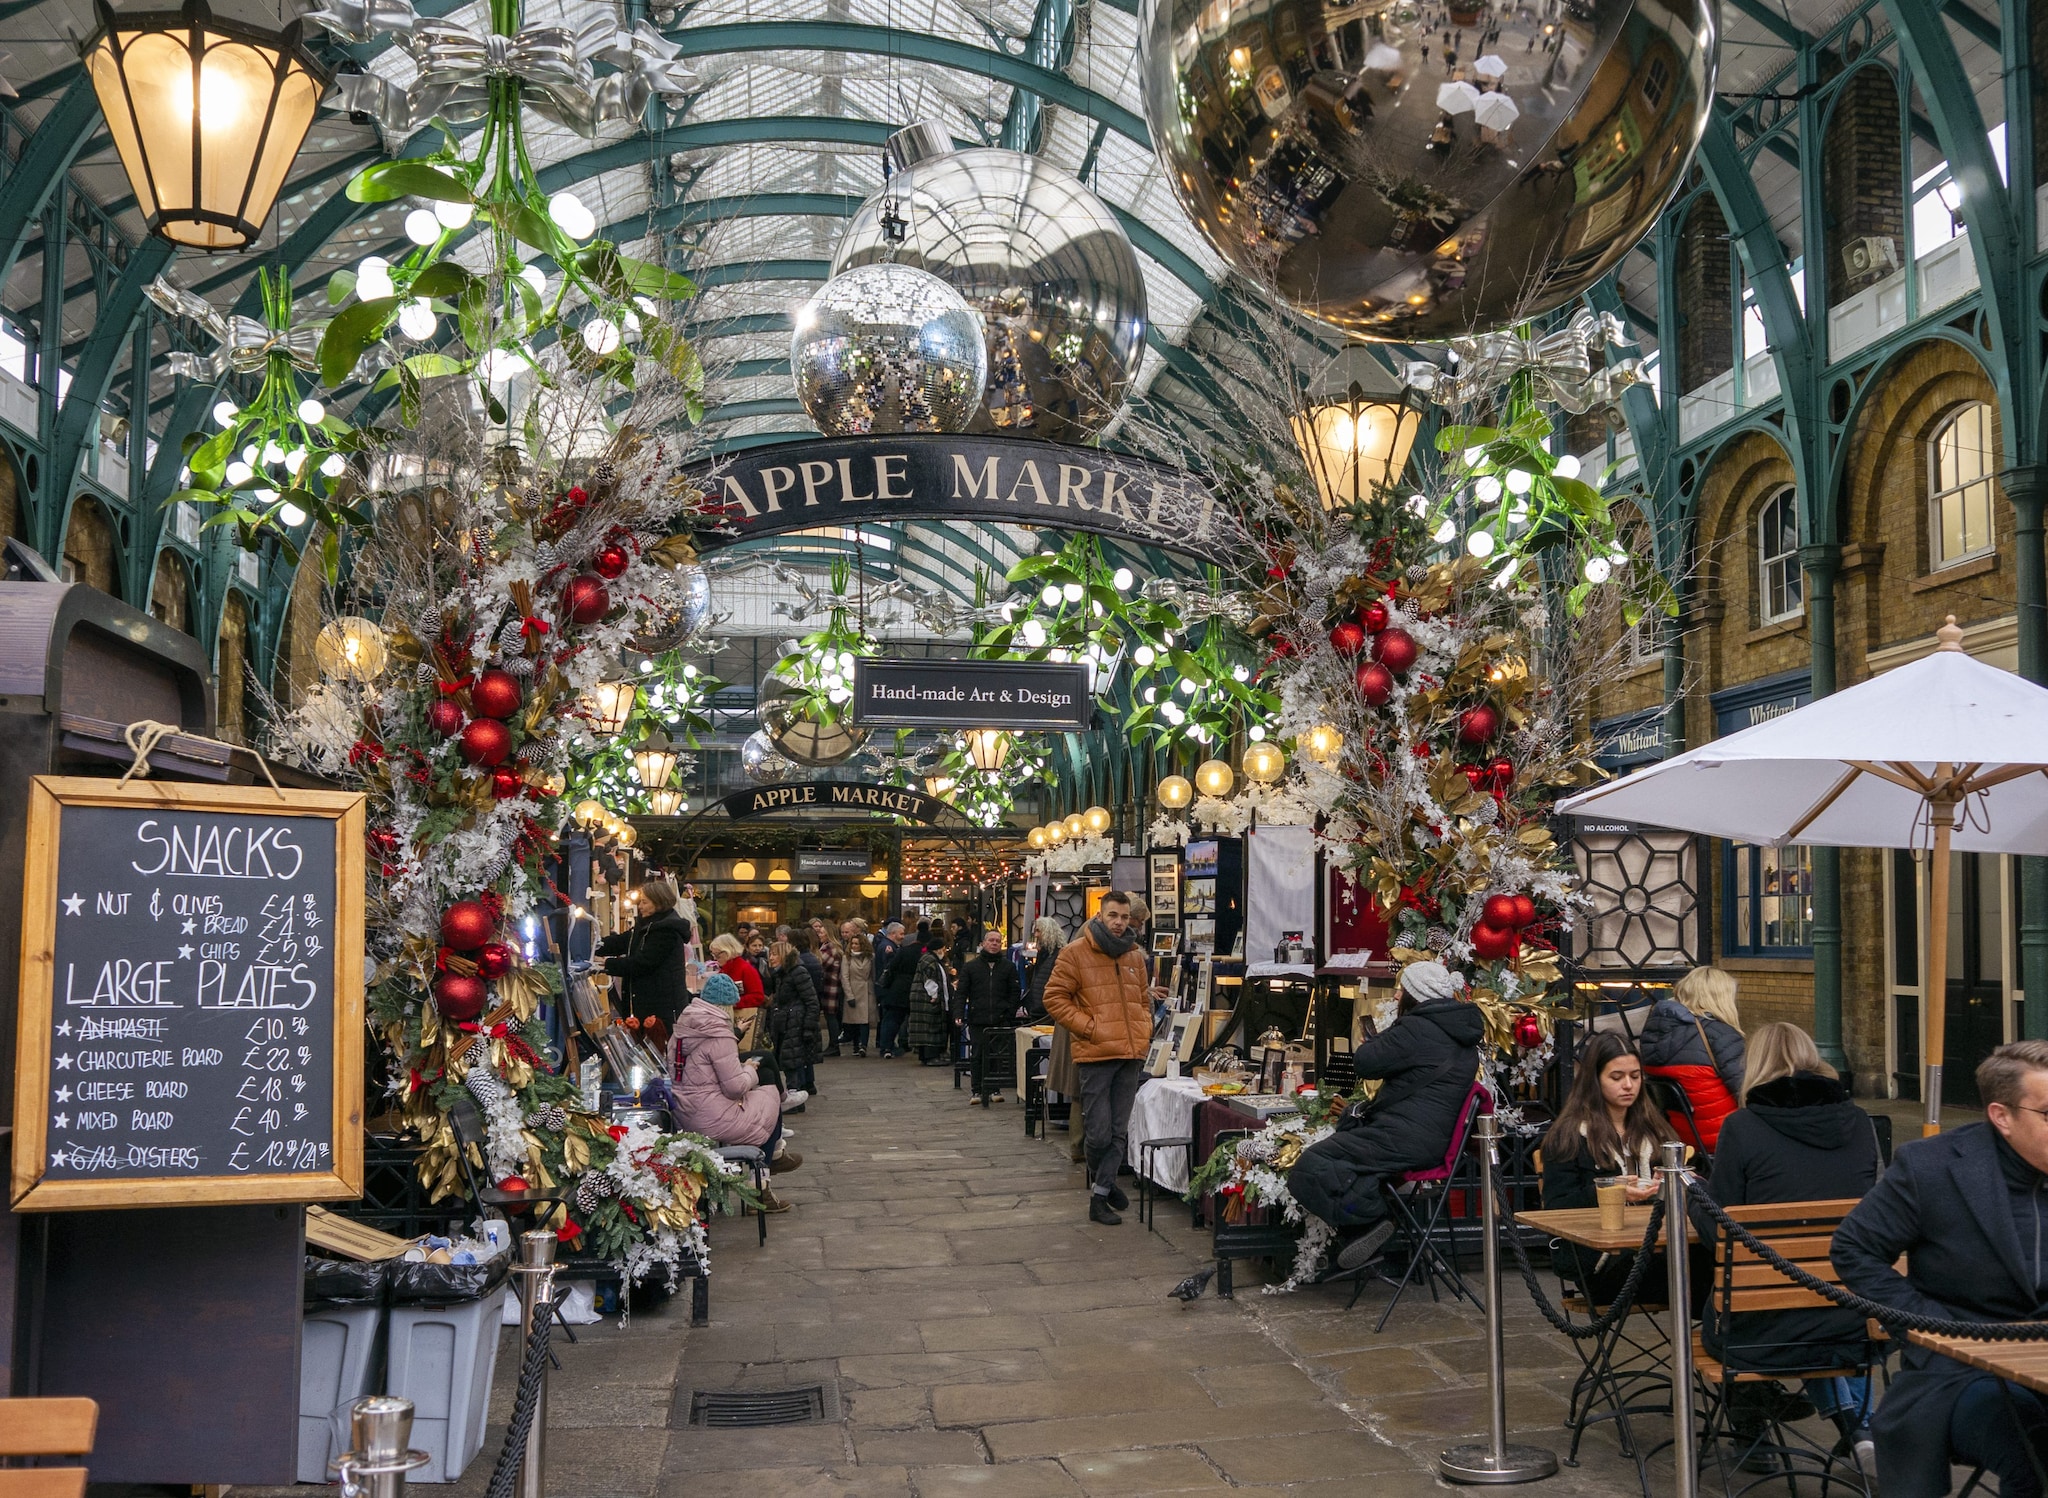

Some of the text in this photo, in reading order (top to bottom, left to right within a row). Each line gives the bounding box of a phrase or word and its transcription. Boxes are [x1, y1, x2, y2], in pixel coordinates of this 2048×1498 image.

[722, 455, 914, 518] APPLE
[872, 684, 1071, 707] Hand-made Art & Design
[1619, 726, 1659, 753] Whittard
[752, 786, 924, 814] APPLE MARKET
[131, 820, 303, 880] SNACKS
[848, 860, 867, 868] Design
[96, 891, 132, 916] NUT
[172, 894, 223, 917] OLIVES
[203, 916, 249, 935] BREAD
[200, 942, 241, 960] CHIPS
[66, 958, 317, 1010] LARGE PLATES
[76, 1050, 175, 1072] CHARCUTERIE
[182, 1047, 223, 1067] BOARD
[76, 1081, 135, 1101] CHEESE
[146, 1081, 188, 1099] BOARD
[76, 1112, 118, 1131] MIXED
[131, 1109, 174, 1131] BOARD
[128, 1146, 199, 1170] OYSTERS
